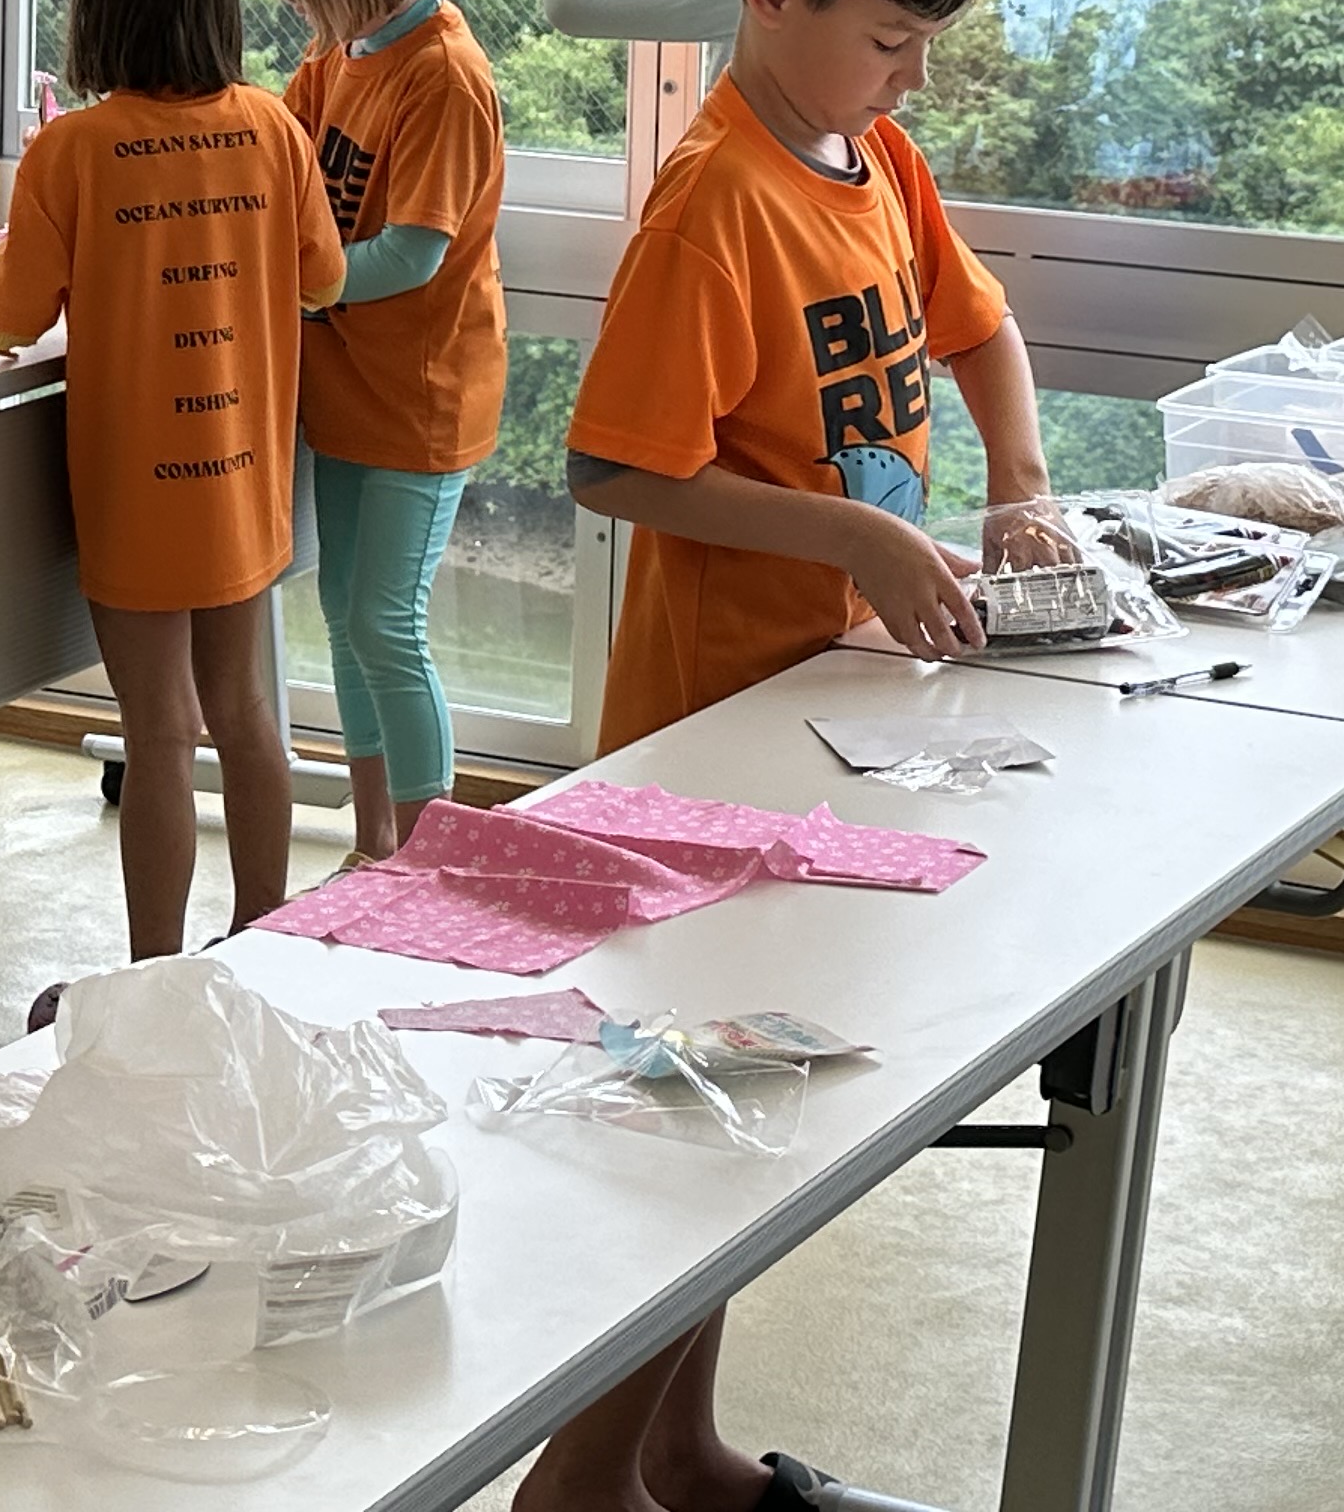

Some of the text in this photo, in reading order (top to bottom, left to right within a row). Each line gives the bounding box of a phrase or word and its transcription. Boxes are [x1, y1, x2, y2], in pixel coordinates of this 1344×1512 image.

[114, 129, 259, 158] OCEAN SAFETY
[115, 193, 269, 224] OCEAN SURVIVAL
[161, 261, 238, 285] SURFING
[803, 257, 925, 377] BLU
[174, 326, 234, 349] DIVING
[174, 388, 240, 414] FISHING
[154, 449, 256, 480] COMMUNITY
